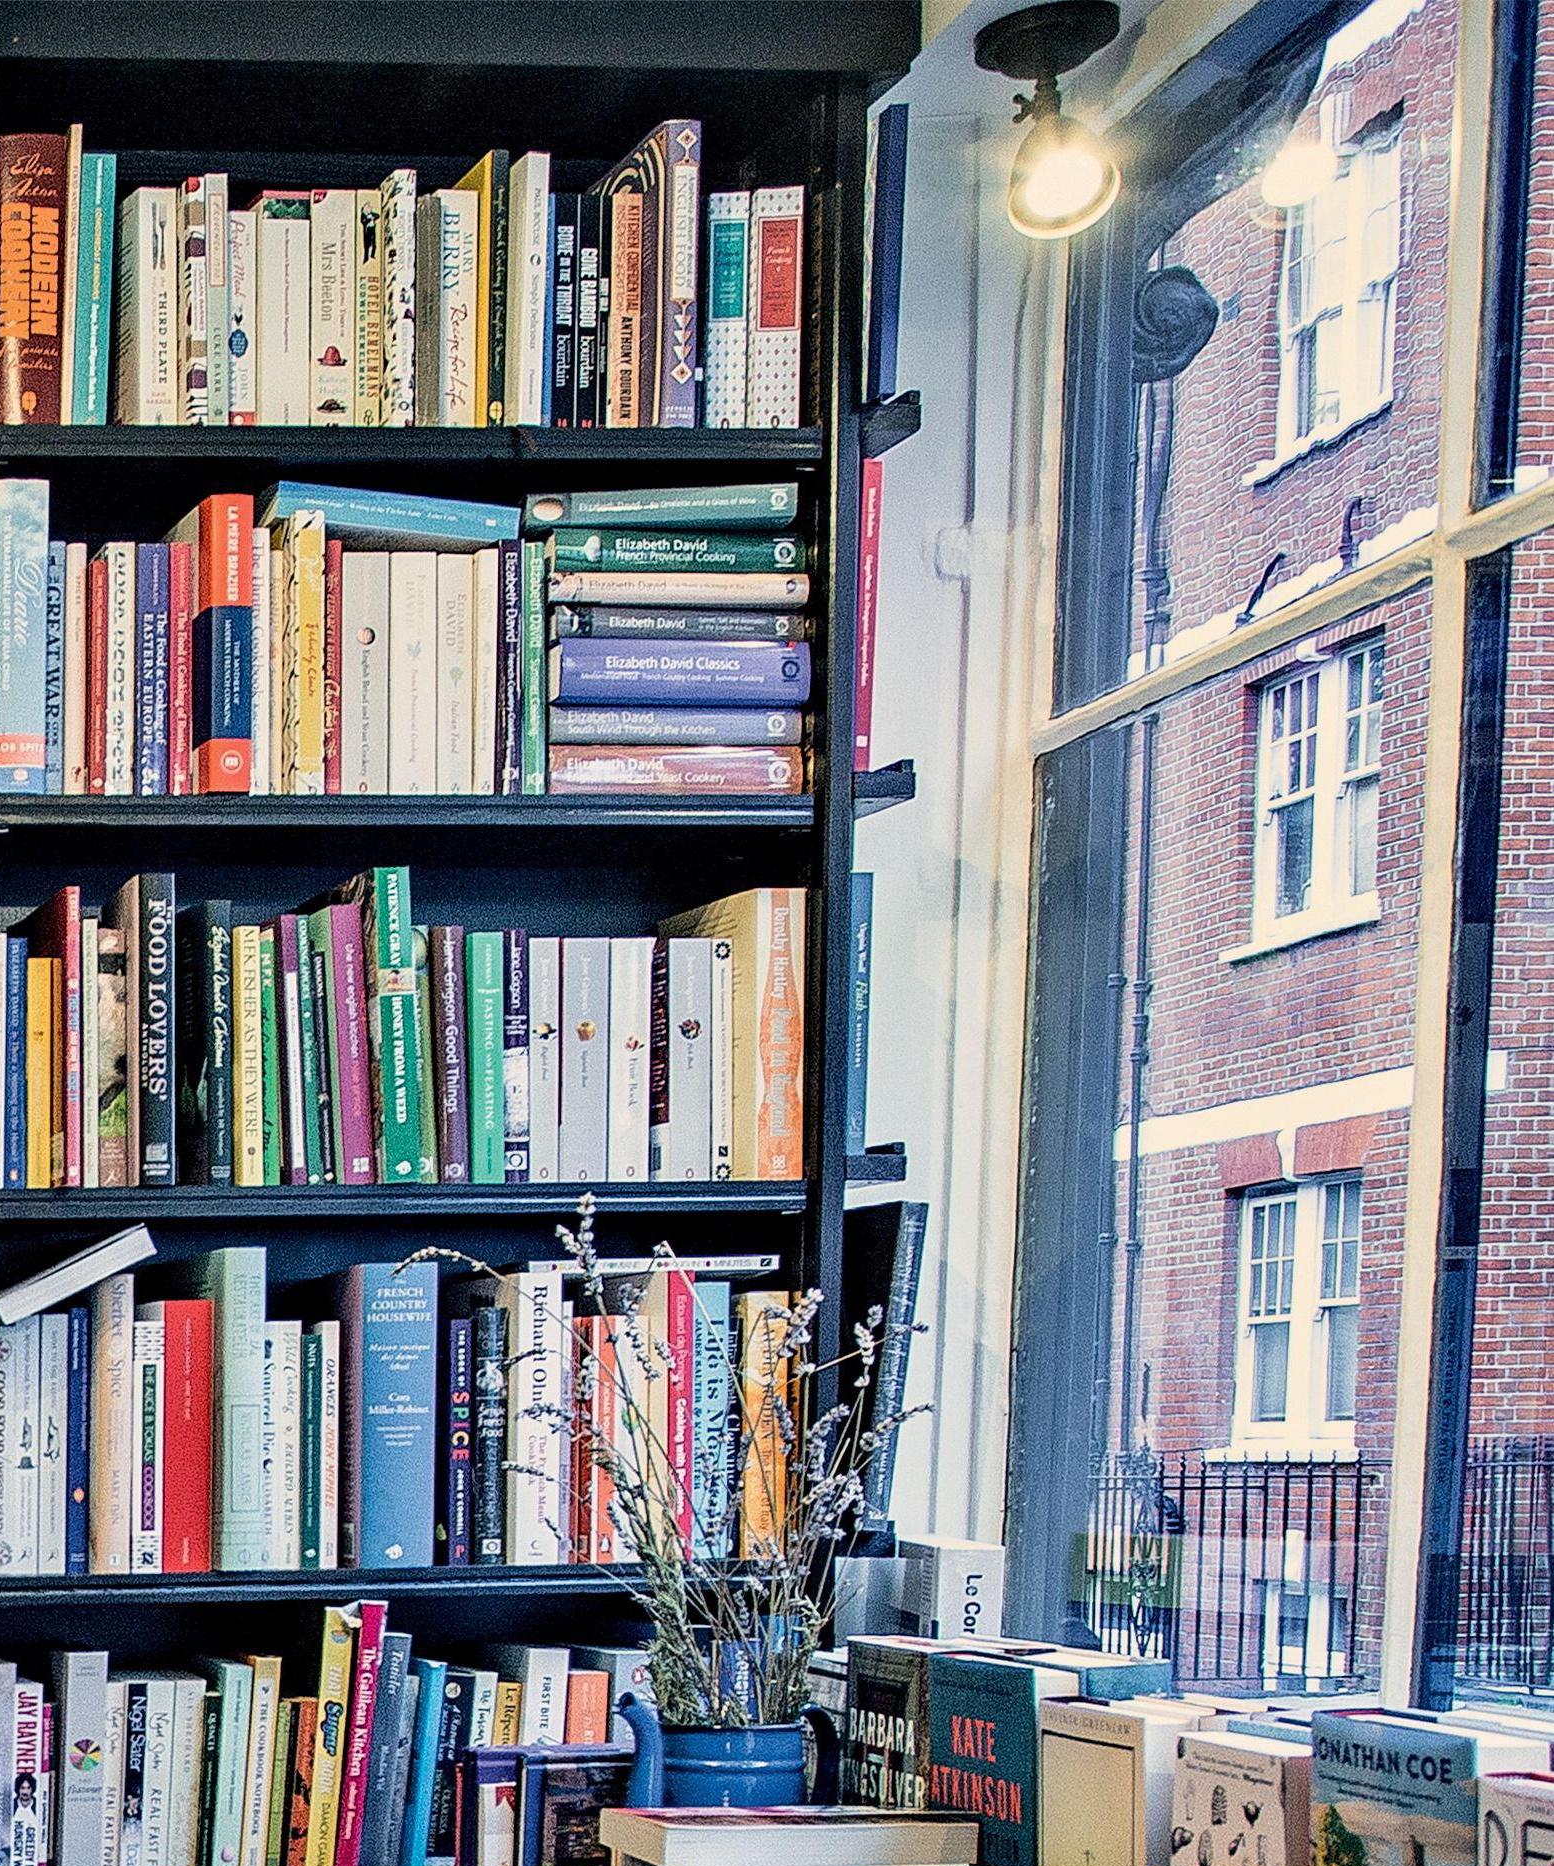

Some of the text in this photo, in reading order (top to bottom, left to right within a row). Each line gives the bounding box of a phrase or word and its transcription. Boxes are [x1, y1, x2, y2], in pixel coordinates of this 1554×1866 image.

[33, 207, 58, 336] MODERN
[615, 539, 709, 553] Elizabeth David
[651, 552, 696, 564] Provincial
[149, 899, 169, 972] FOOD
[371, 1299, 428, 1310] COUNTRY
[377, 1287, 424, 1298] FRENCH
[366, 1311, 432, 1323] HOUSEWIFE
[17, 1690, 39, 1774] JAY RAYNER
[849, 1708, 915, 1756] BARBARA
[950, 1714, 996, 1762] KATE
[1407, 1755, 1454, 1784] COE
[929, 1763, 1022, 1824] ATKINSON
